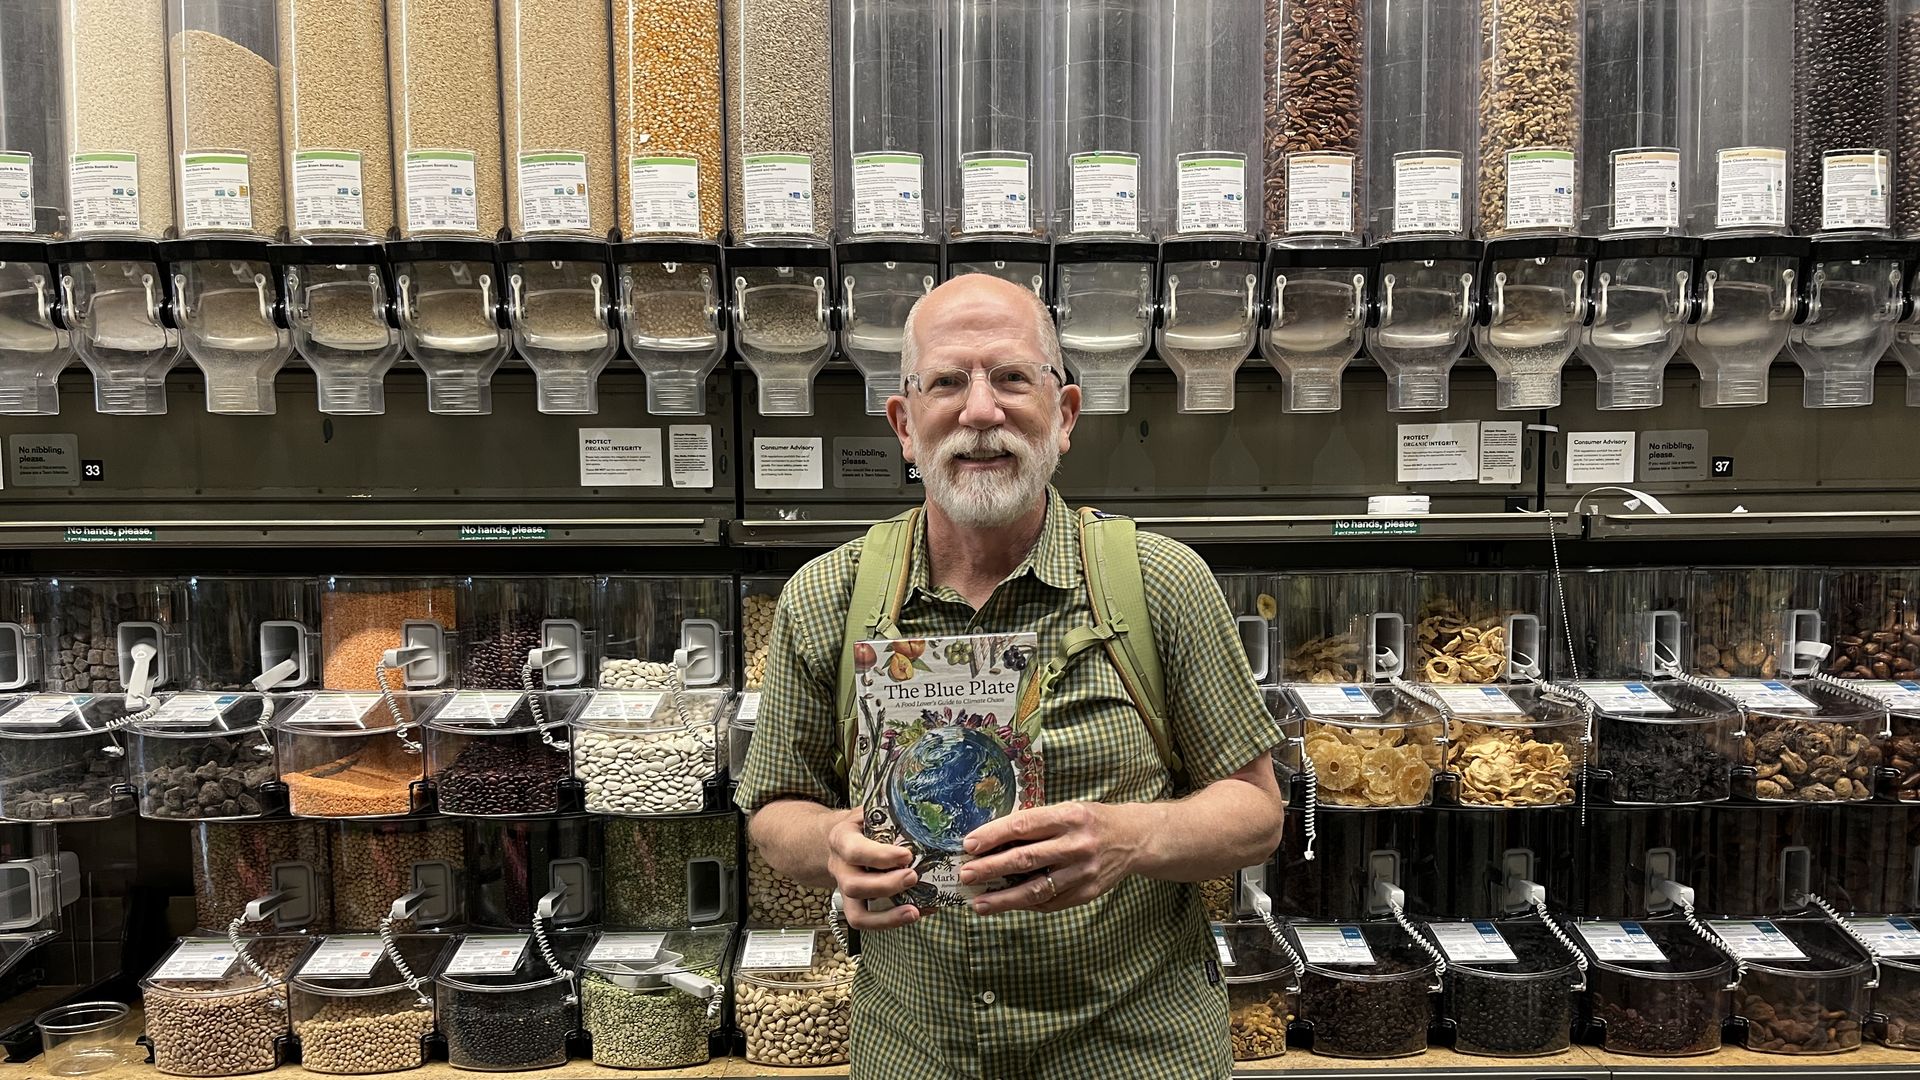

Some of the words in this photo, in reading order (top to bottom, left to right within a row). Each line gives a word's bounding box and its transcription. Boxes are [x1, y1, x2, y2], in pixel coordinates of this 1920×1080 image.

[32, 446, 65, 455] nibbling,
[1661, 442, 1694, 450] nibbling,
[854, 449, 888, 458] nibbling,
[1649, 452, 1675, 460] please.
[842, 458, 868, 466] please.
[1715, 461, 1729, 472] 37
[85, 465, 100, 476] 33
[908, 468, 921, 479] 35
[1335, 520, 1350, 528] No
[1351, 520, 1383, 530] hands,
[1385, 520, 1417, 530] please.
[83, 526, 116, 537] hands,
[118, 527, 152, 537] please.
[462, 526, 476, 534] No
[478, 525, 510, 535] hands,
[512, 525, 546, 536] please.
[884, 684, 919, 700] The
[924, 682, 964, 698] Blue
[969, 680, 1015, 695] Plate
[932, 874, 955, 882] Mark
